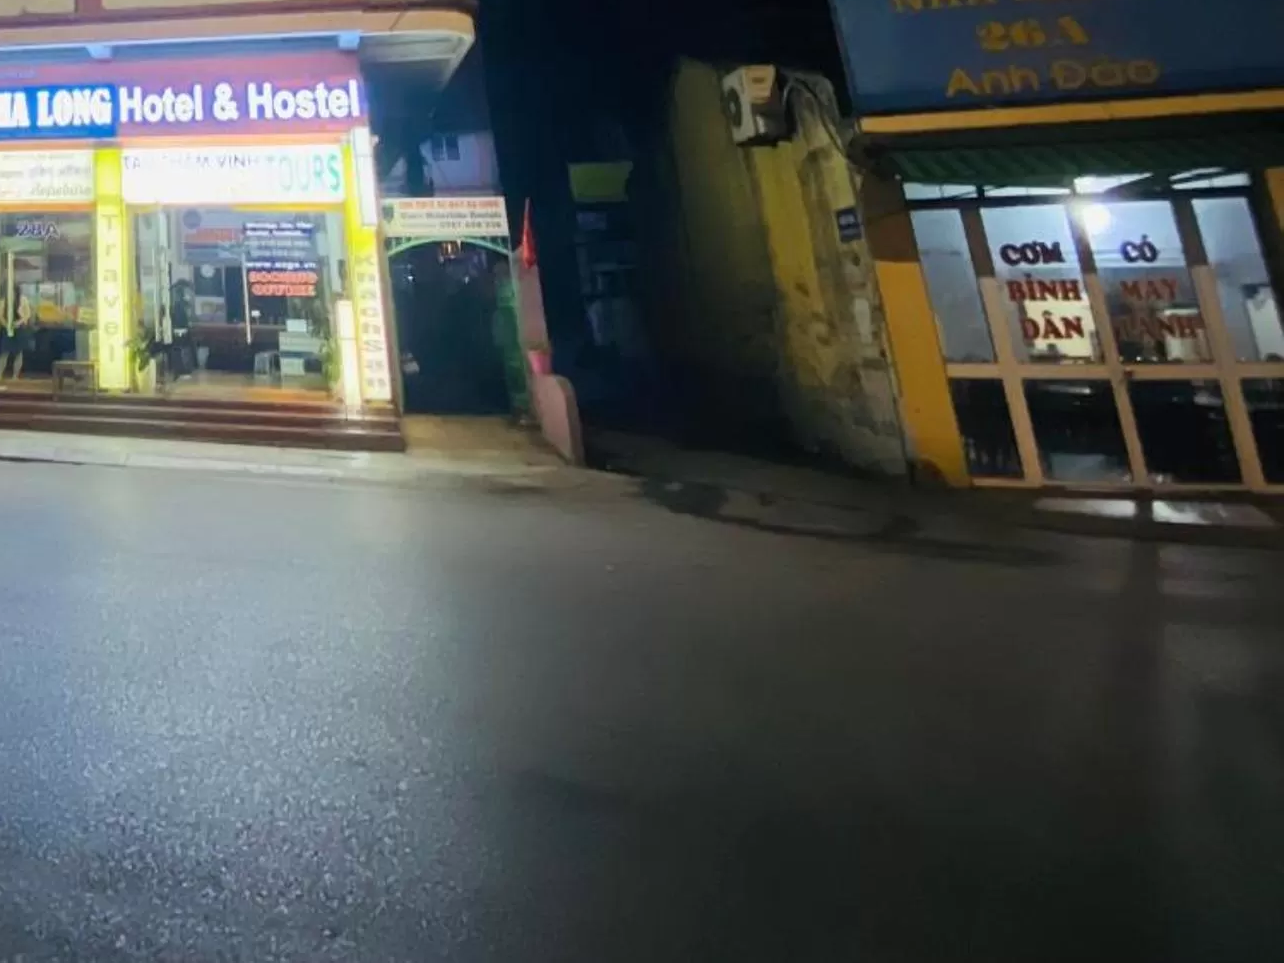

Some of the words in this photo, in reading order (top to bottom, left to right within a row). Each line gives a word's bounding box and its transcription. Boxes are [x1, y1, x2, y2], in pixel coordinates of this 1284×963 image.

[946, 64, 1040, 99] Anh
[36, 88, 112, 127] LONG
[119, 84, 203, 123] Hotel
[213, 82, 240, 120] &
[248, 78, 361, 120] Hostel
[1000, 240, 1065, 266] CƠM
[1120, 234, 1159, 264] CÓ
[1006, 273, 1083, 302] BÌNH
[1020, 310, 1085, 340] DÂN
